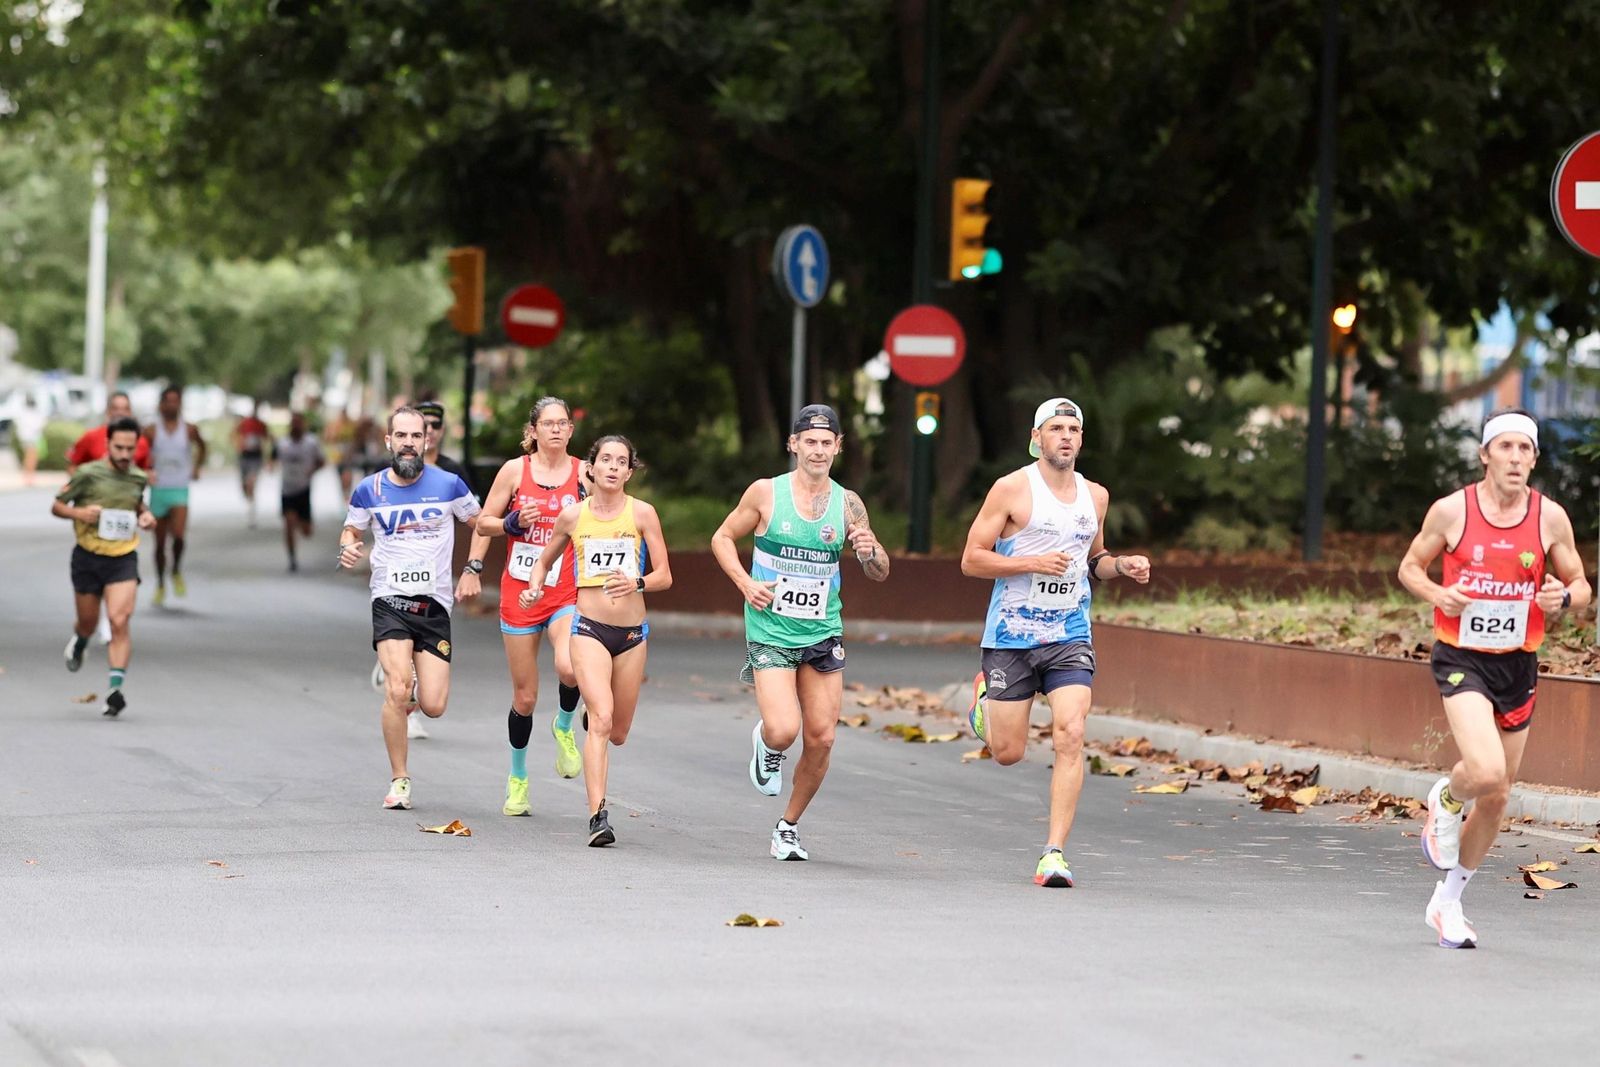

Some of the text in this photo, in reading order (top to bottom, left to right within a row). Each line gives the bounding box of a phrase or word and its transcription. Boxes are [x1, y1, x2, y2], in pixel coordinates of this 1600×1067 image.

[538, 516, 556, 524] LETIS
[525, 522, 554, 544] Véle
[591, 552, 626, 566] 477
[780, 546, 830, 562] ATLETISMO
[516, 555, 540, 568] 10
[392, 571, 430, 583] 1200
[1037, 581, 1076, 595] 1067
[782, 590, 820, 607] 403
[1470, 616, 1516, 634] 624
